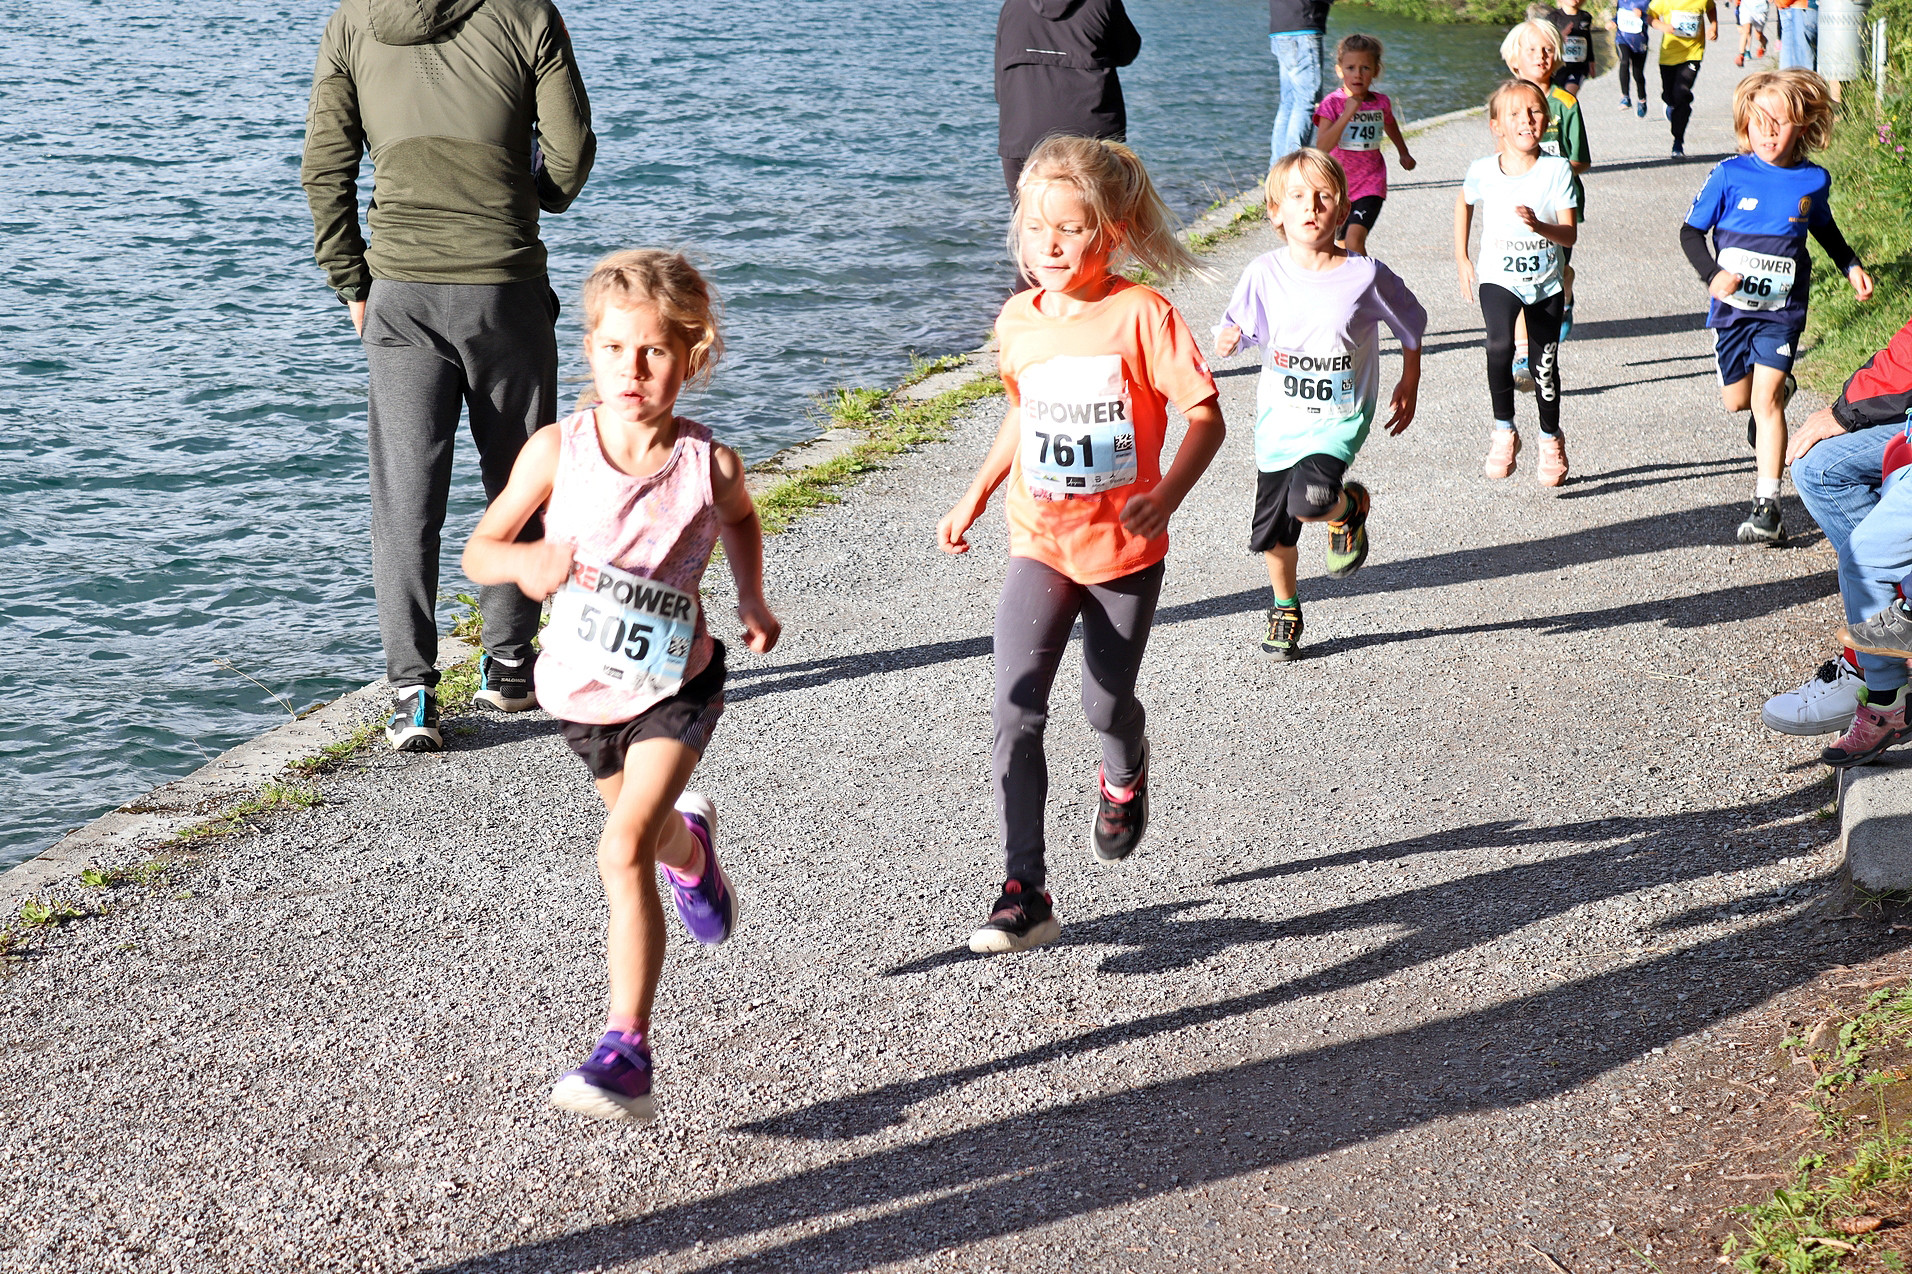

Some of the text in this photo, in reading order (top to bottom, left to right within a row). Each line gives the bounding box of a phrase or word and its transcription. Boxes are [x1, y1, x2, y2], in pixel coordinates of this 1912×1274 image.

[1350, 126, 1375, 140] 749
[1503, 255, 1540, 273] 263
[1273, 350, 1352, 372] REPOWER
[1535, 341, 1557, 401] adidas
[1284, 375, 1333, 401] 966
[1035, 431, 1094, 468] 761
[573, 561, 692, 622] REPOWER
[577, 603, 654, 661] 505
